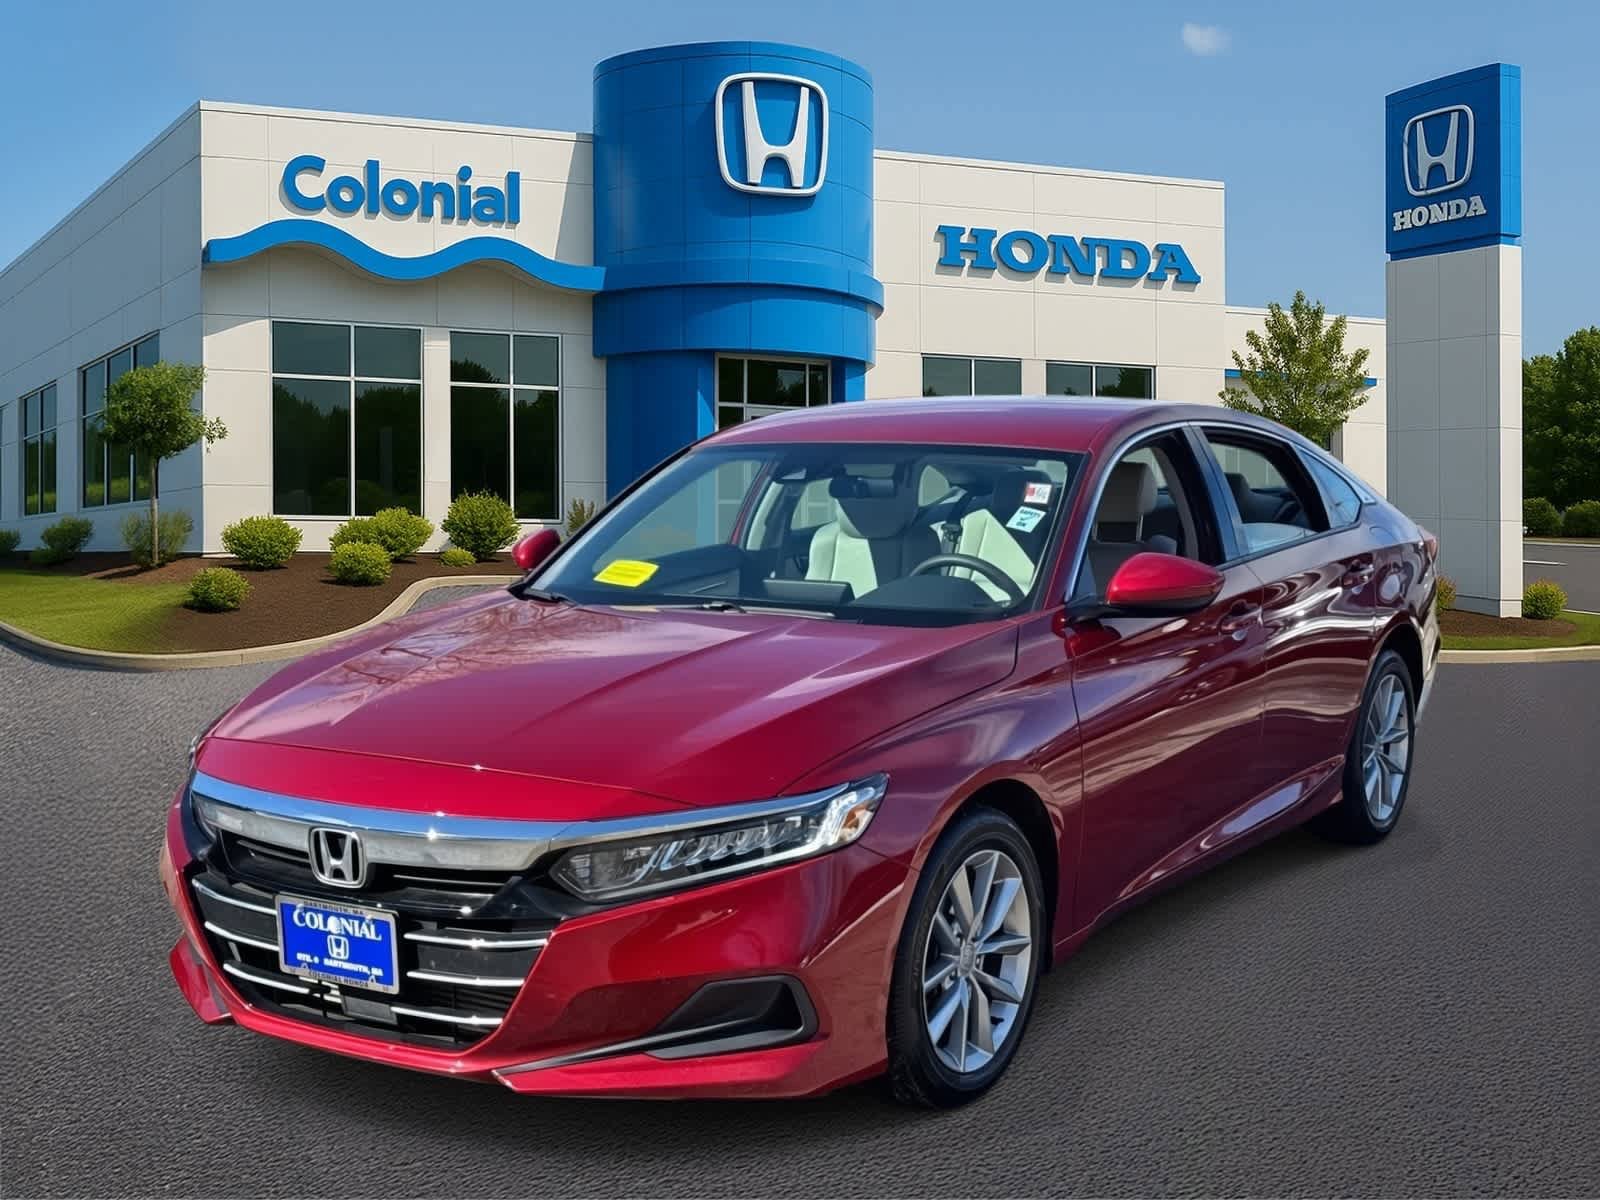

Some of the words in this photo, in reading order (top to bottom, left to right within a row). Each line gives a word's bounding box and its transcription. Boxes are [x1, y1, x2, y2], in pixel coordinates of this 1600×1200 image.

[282, 155, 520, 226] Colonial
[1393, 195, 1487, 231] HONDA
[937, 224, 1201, 284] HONDA
